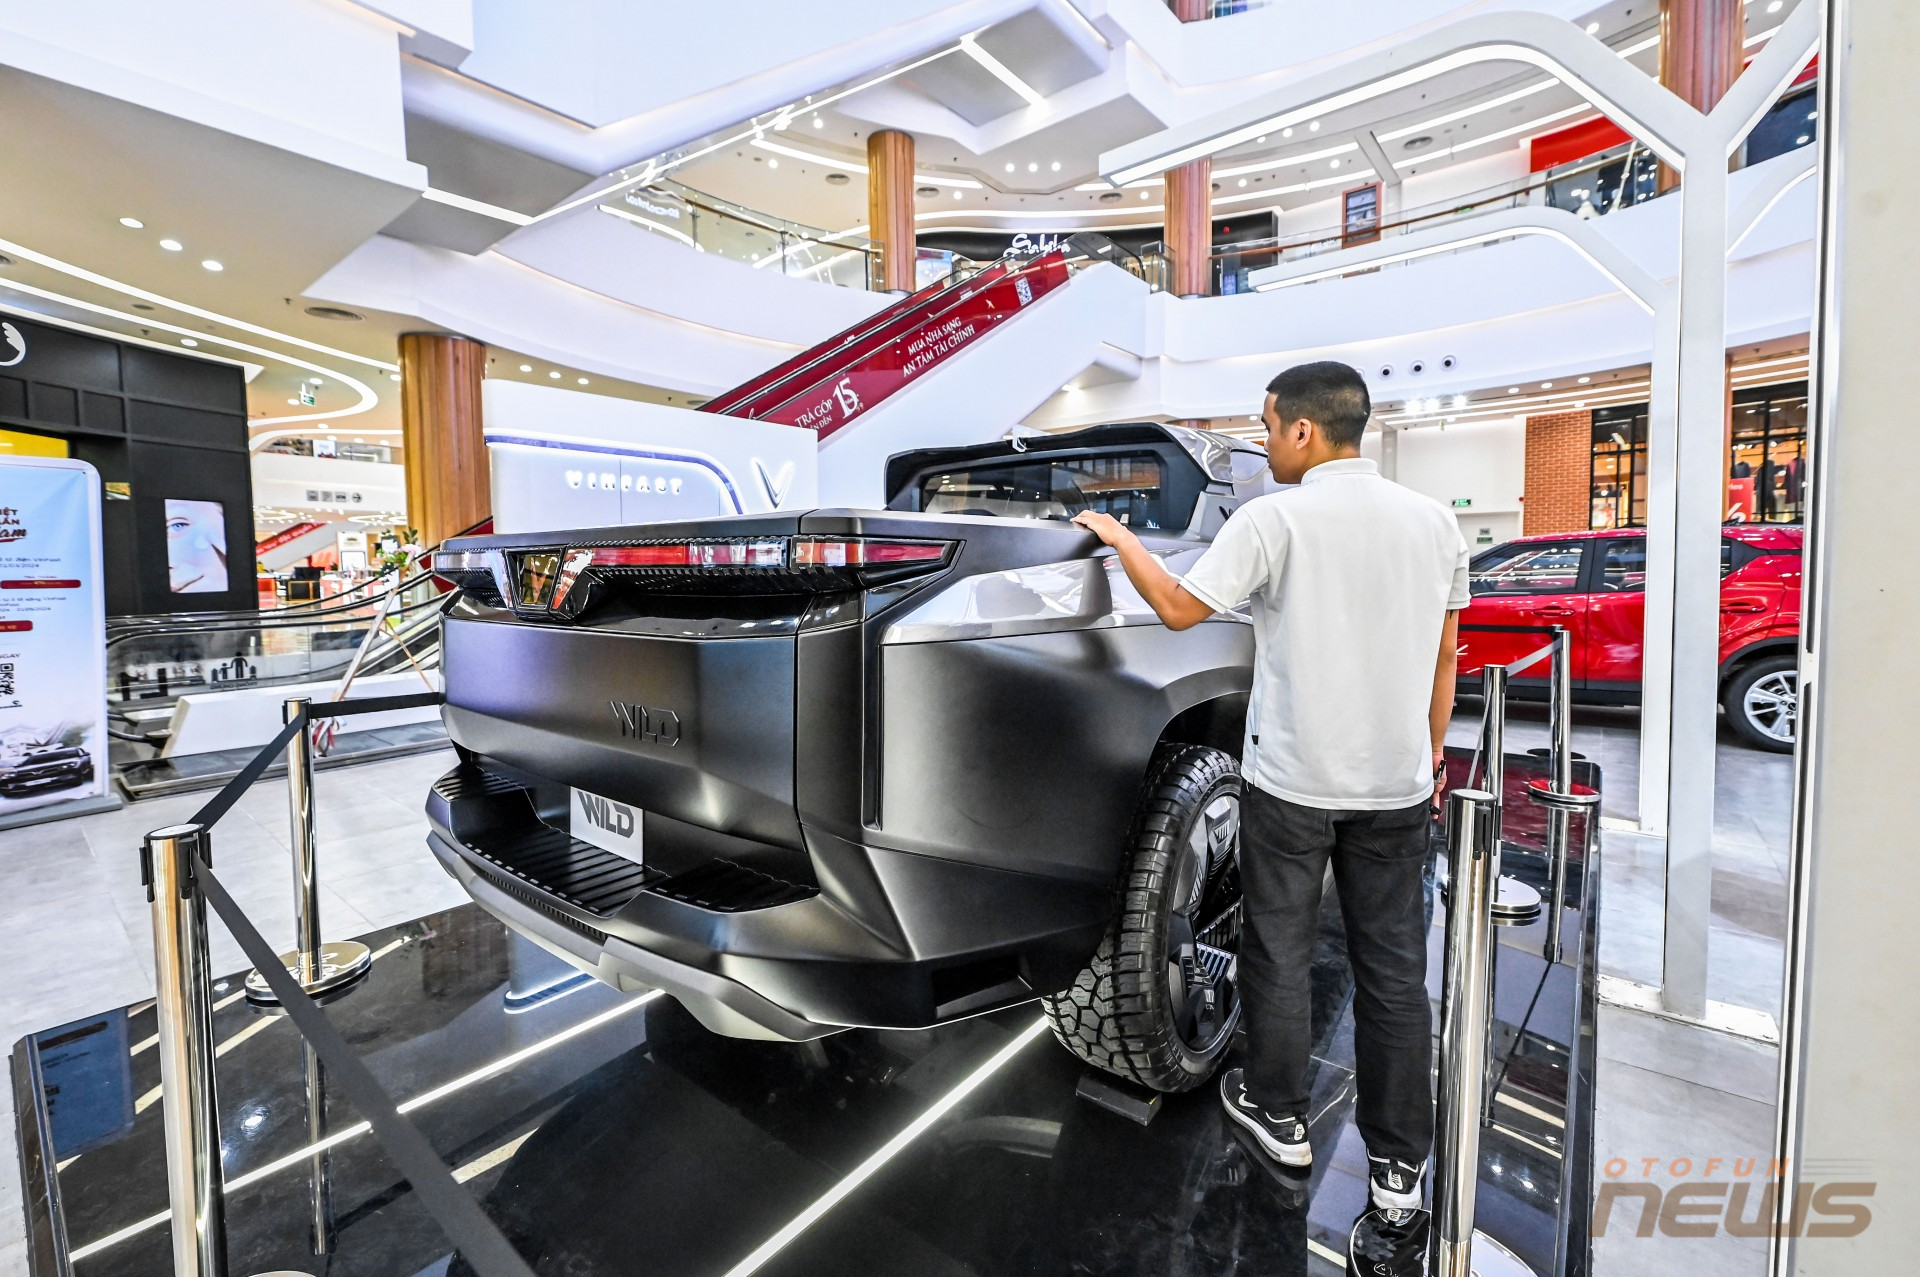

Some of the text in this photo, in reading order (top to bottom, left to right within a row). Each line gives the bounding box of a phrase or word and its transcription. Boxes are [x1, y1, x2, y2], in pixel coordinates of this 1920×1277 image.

[903, 324, 976, 377] AN TÂM TÀI CHÍNH
[907, 317, 961, 356] MUA NHÀ SANG
[794, 399, 833, 428] TRẢ GÓP
[833, 377, 859, 419] 15
[566, 470, 682, 495] VINFAST
[577, 790, 635, 839] WILD
